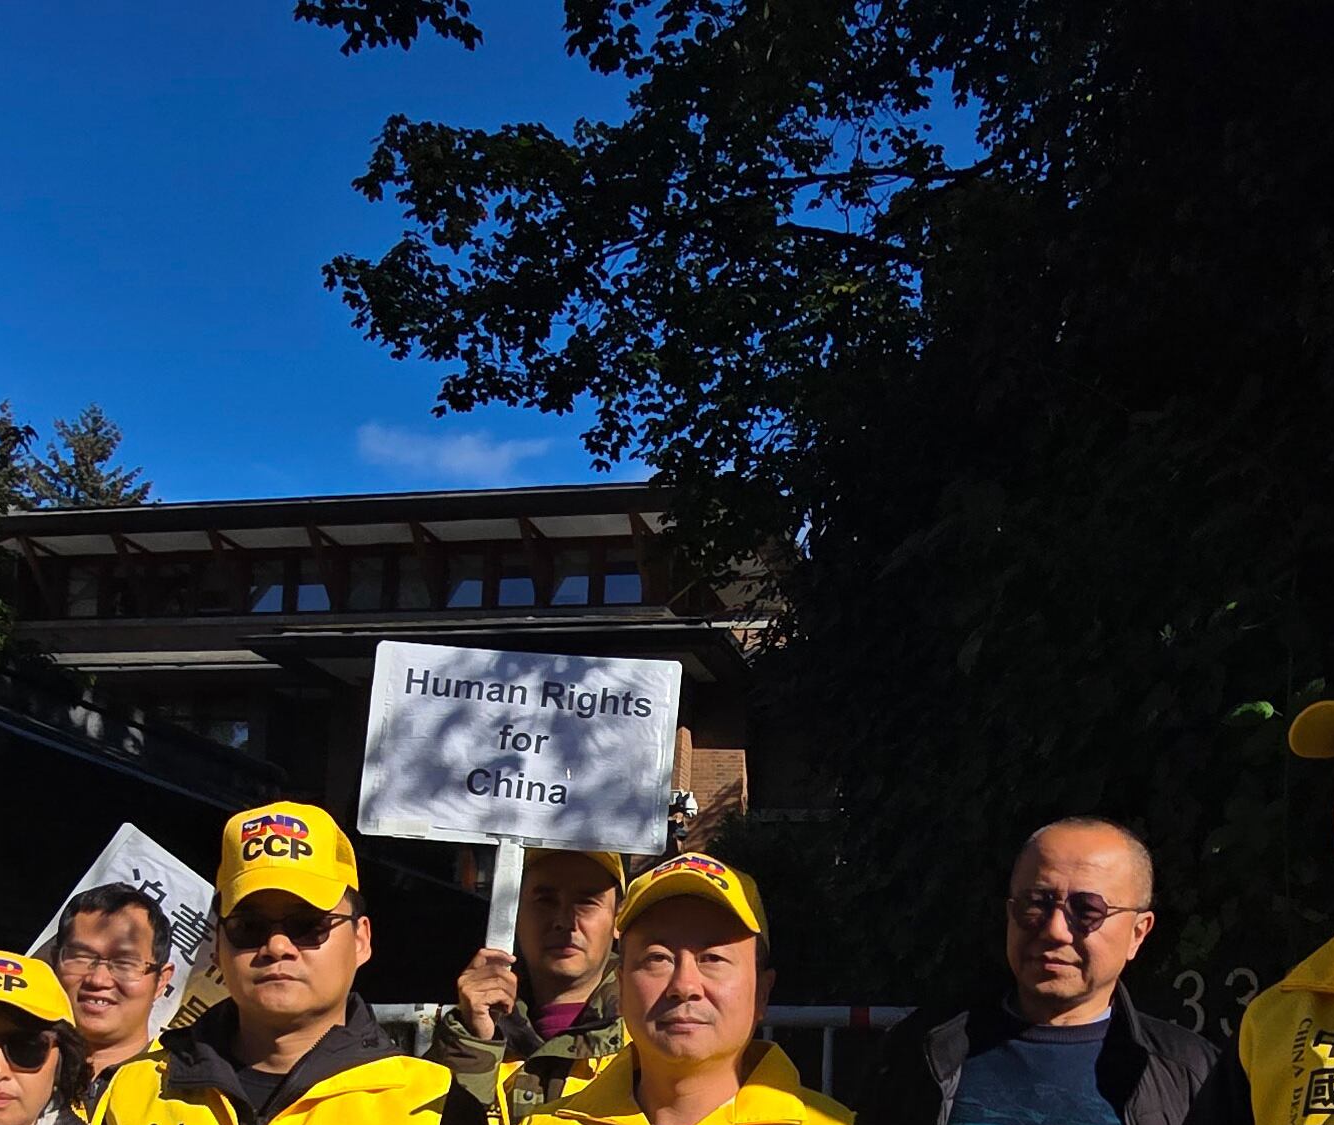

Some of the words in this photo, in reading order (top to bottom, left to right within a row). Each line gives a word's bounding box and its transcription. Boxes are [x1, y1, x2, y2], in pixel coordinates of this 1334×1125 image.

[405, 667, 528, 705] Human
[540, 680, 653, 719] Rights
[498, 724, 550, 754] for
[467, 768, 568, 805] China
[240, 813, 310, 844] END
[242, 834, 313, 862] CCP
[1292, 1017, 1313, 1079] CHINA
